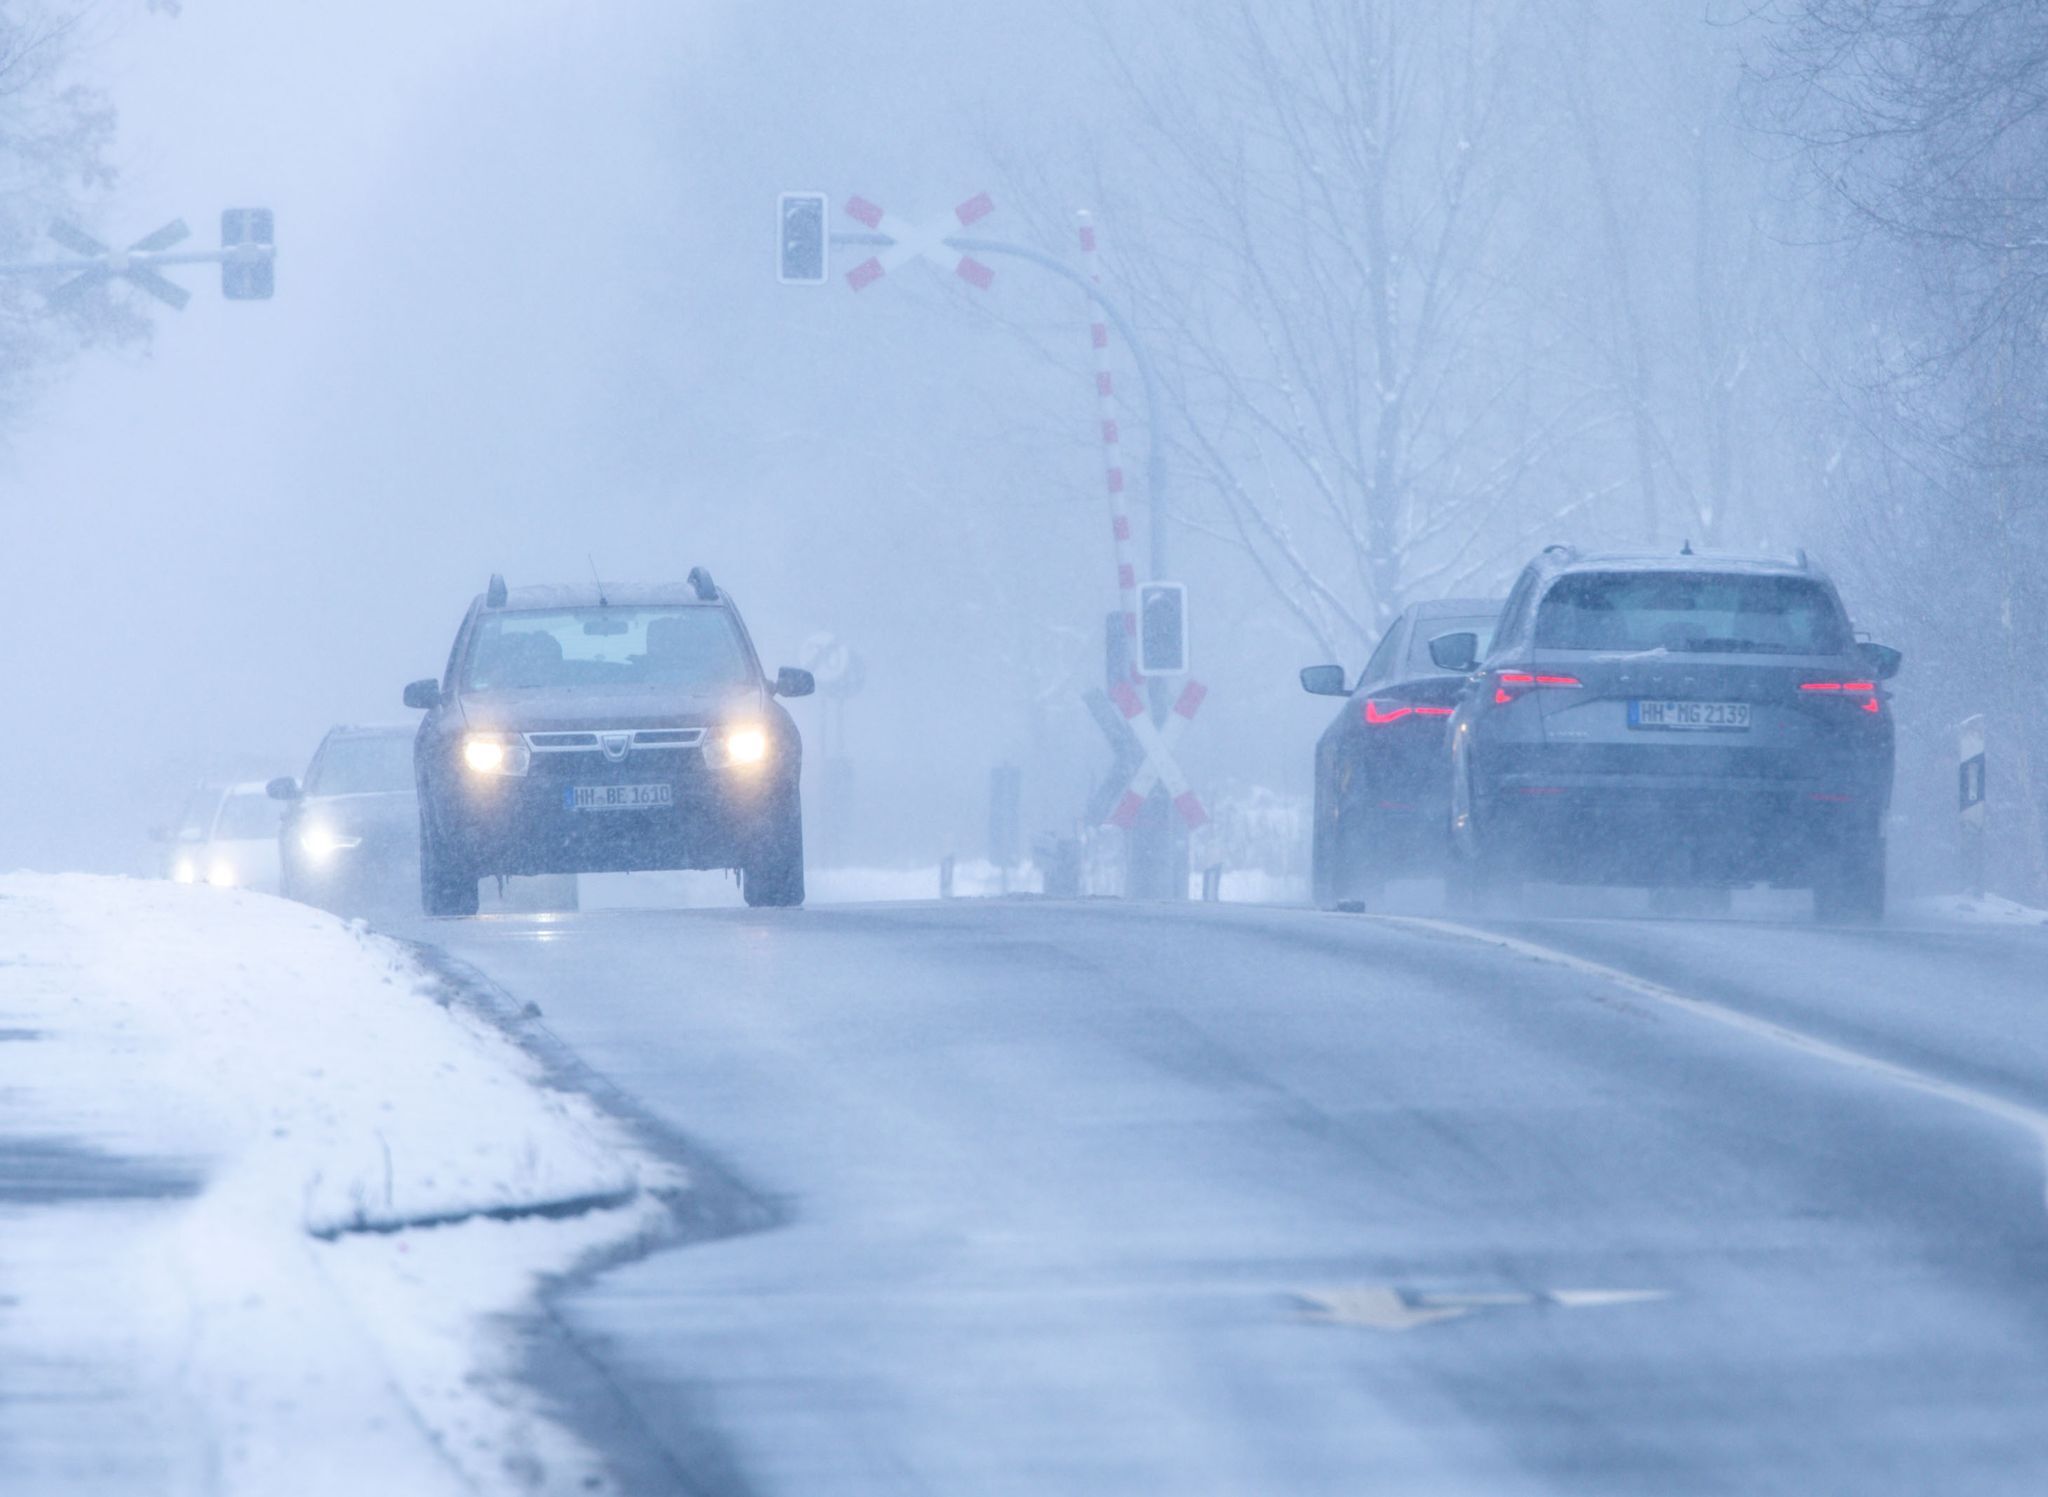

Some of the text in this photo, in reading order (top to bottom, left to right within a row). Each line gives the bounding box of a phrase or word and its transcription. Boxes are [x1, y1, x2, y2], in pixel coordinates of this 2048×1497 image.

[1642, 703, 1748, 724] HH MG 2139
[575, 785, 670, 805] HH BE 1610
